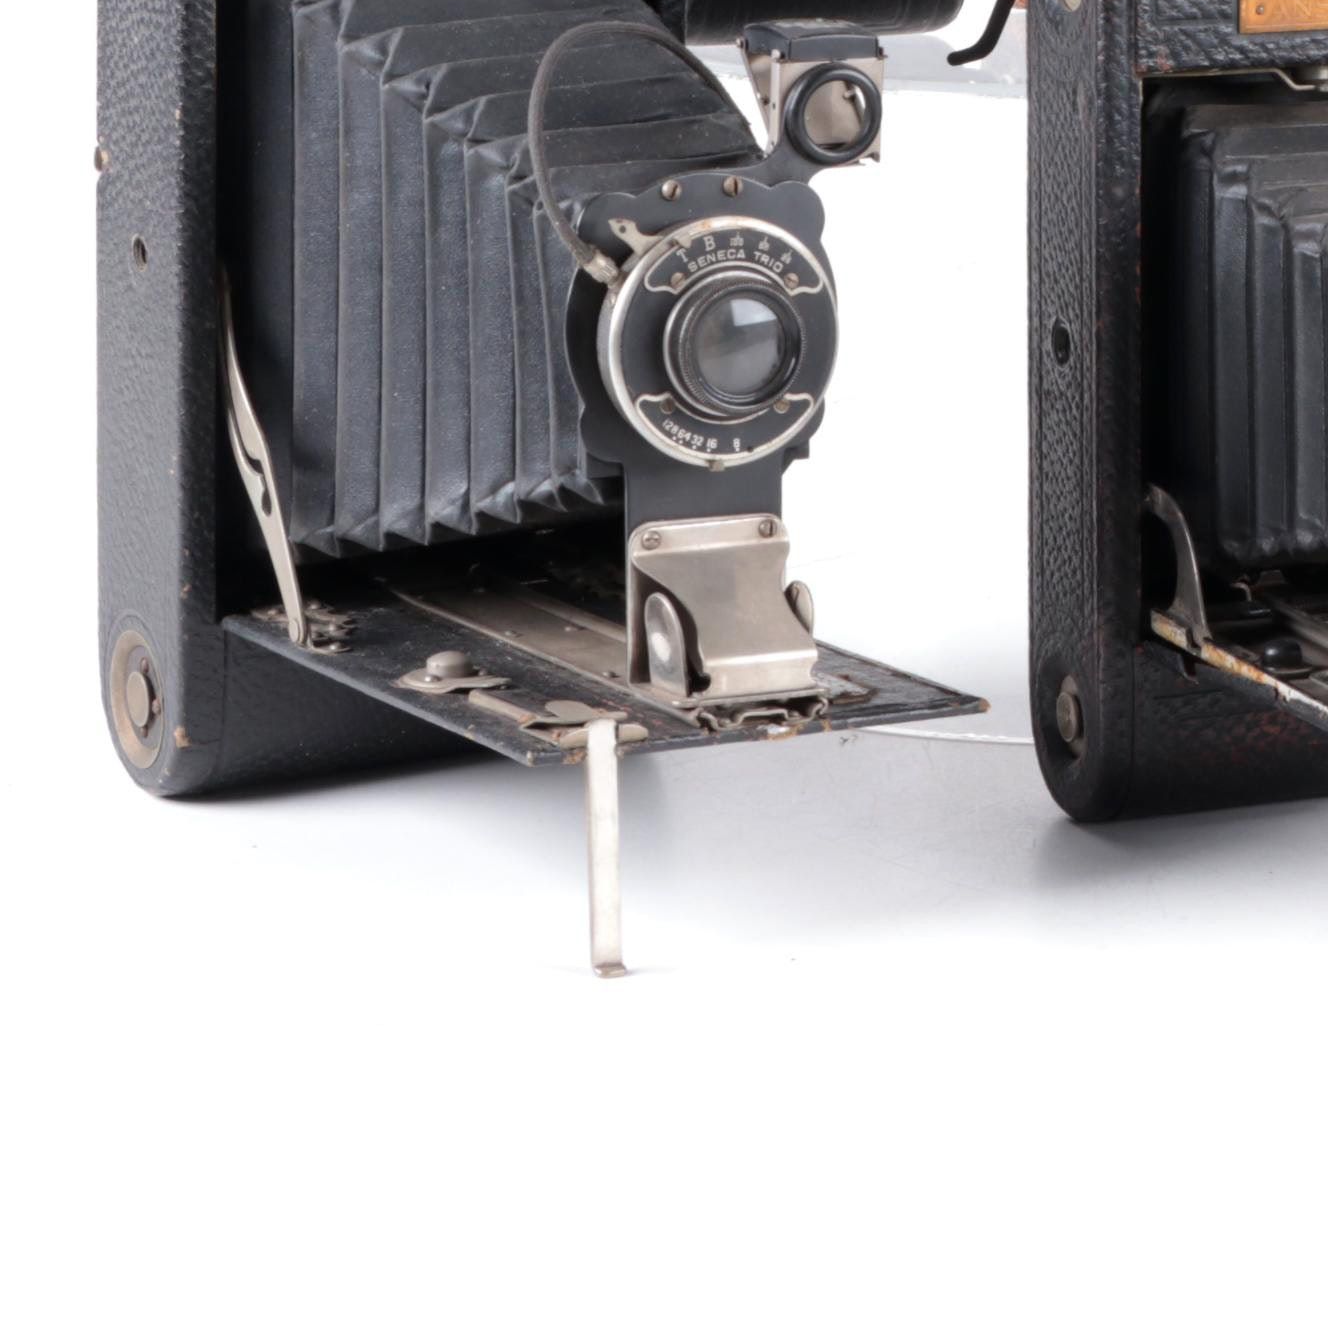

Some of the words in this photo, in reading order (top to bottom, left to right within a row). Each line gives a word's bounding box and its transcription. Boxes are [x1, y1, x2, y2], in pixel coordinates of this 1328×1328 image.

[703, 235, 716, 251] B
[687, 249, 746, 272] SENECA
[753, 251, 784, 273] TRIO
[706, 438, 718, 449] 16
[732, 437, 741, 449] 8
